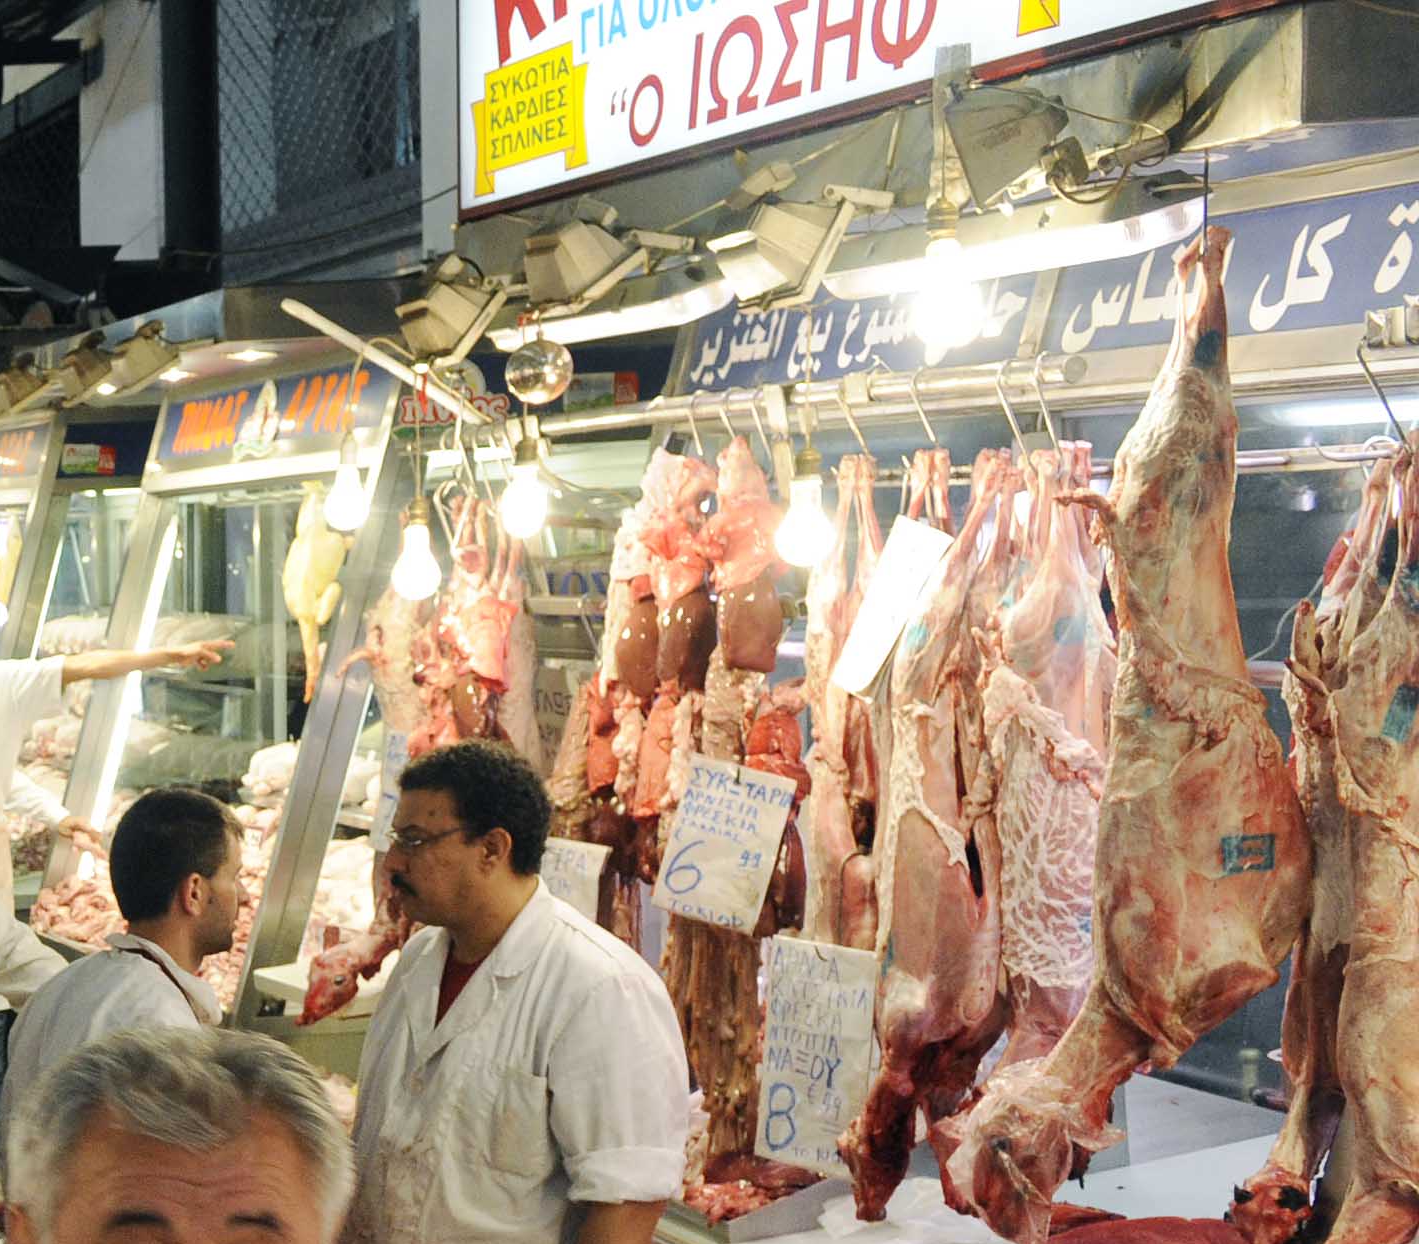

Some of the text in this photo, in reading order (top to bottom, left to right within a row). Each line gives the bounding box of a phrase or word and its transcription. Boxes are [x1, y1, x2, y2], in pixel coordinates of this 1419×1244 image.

[581, 8, 627, 54] ΓΙΑ
[490, 56, 570, 104] ΣΥΚΩΤΙΑ
[688, 0, 938, 129] ΙΩΣΗΦ
[490, 85, 567, 131] ΚΑΡΔΙΕΣ
[490, 115, 568, 159] ΣΠΛΙΝΕΣ
[665, 840, 702, 894] 6
